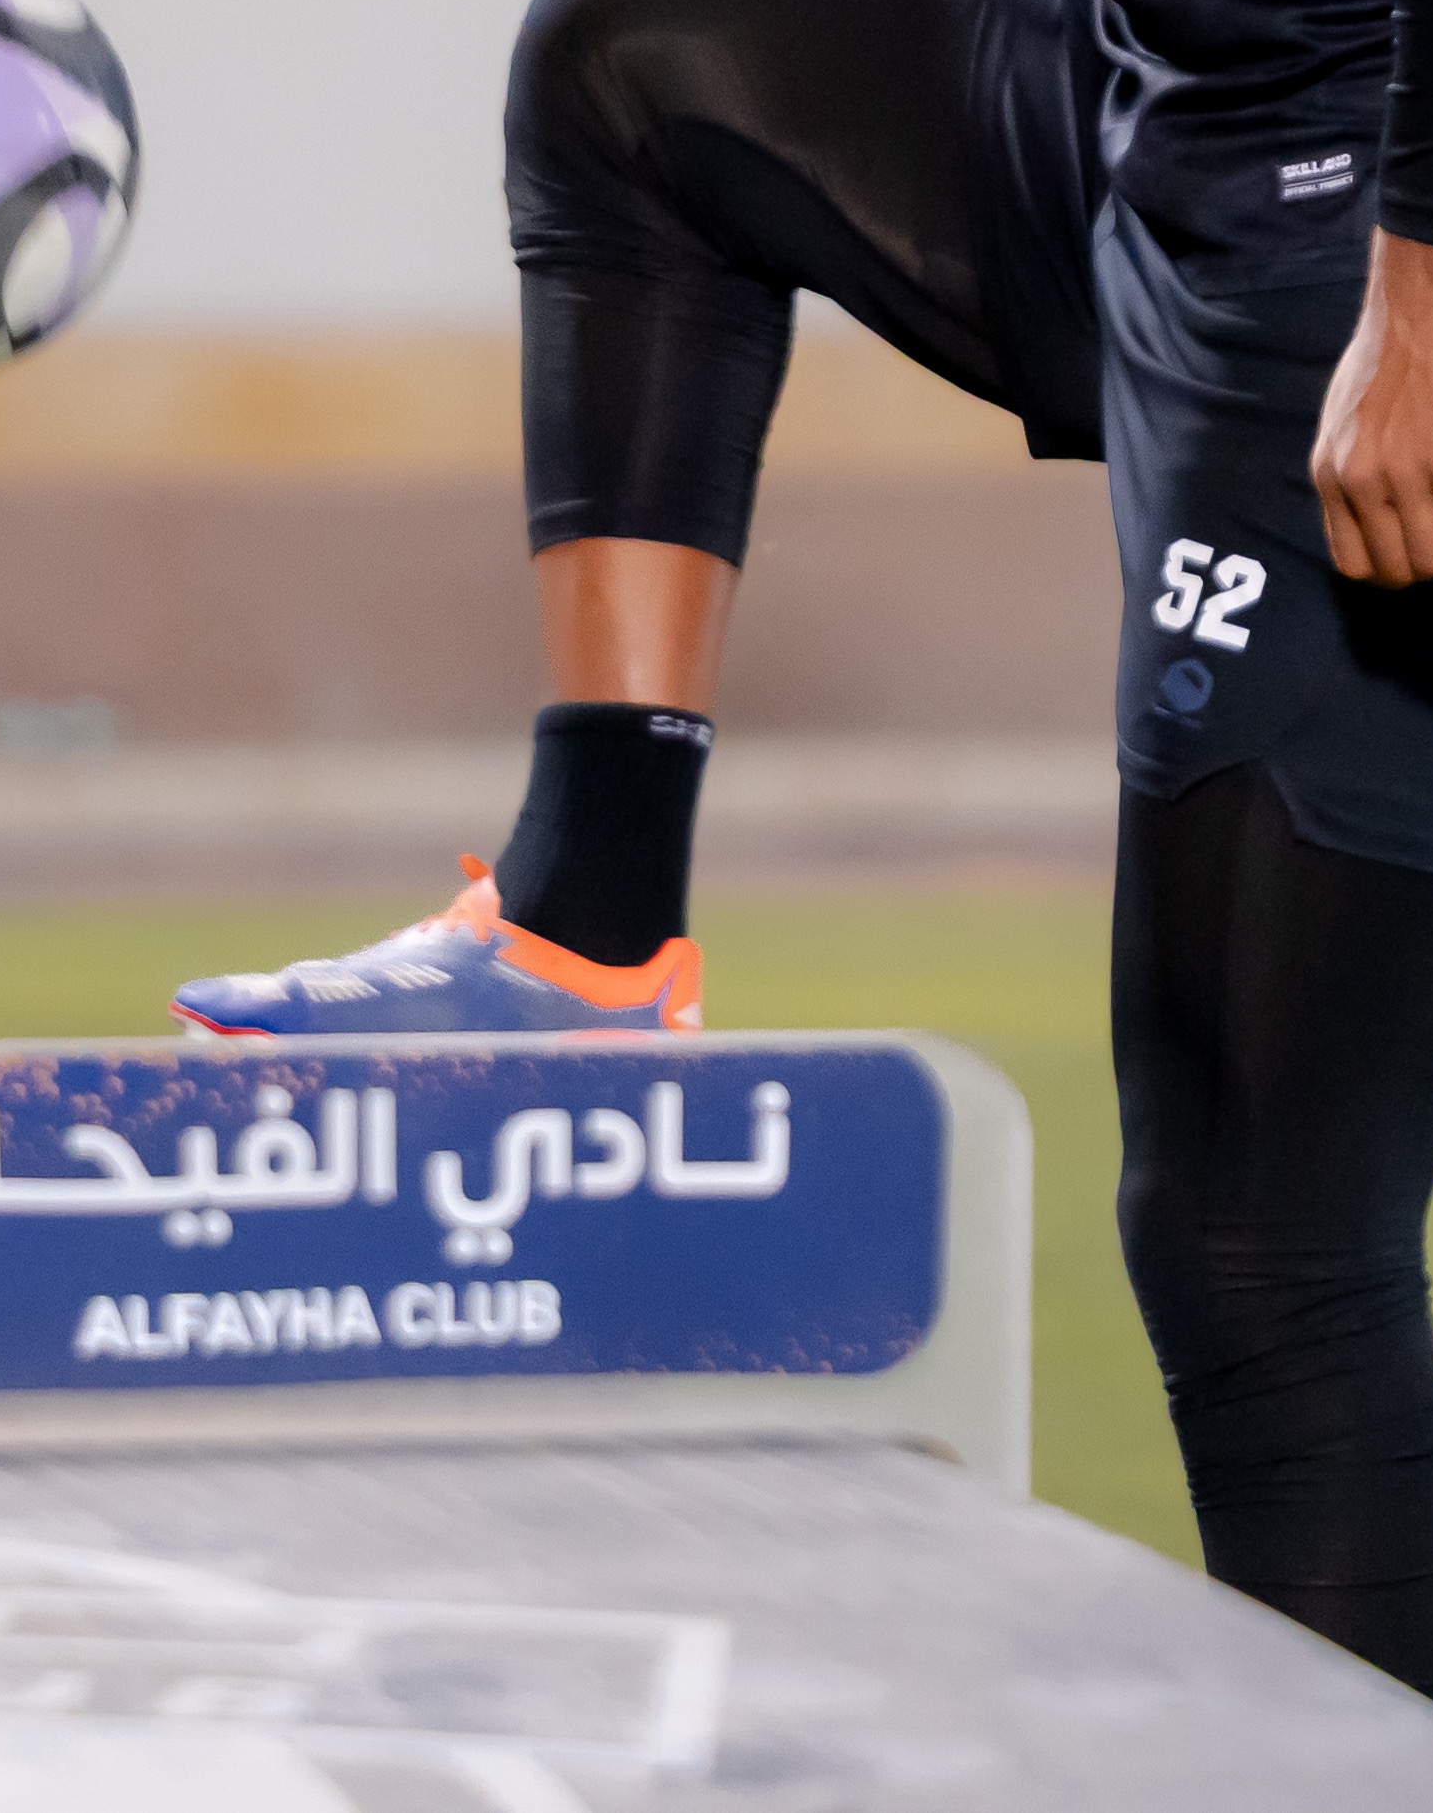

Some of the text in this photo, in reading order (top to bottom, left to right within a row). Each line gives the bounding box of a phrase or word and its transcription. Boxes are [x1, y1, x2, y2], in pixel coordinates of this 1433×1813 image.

[1152, 538, 1267, 653] 52
[425, 1080, 791, 1265] نادي
[75, 1280, 562, 1360] ALFAYHA CLUB
